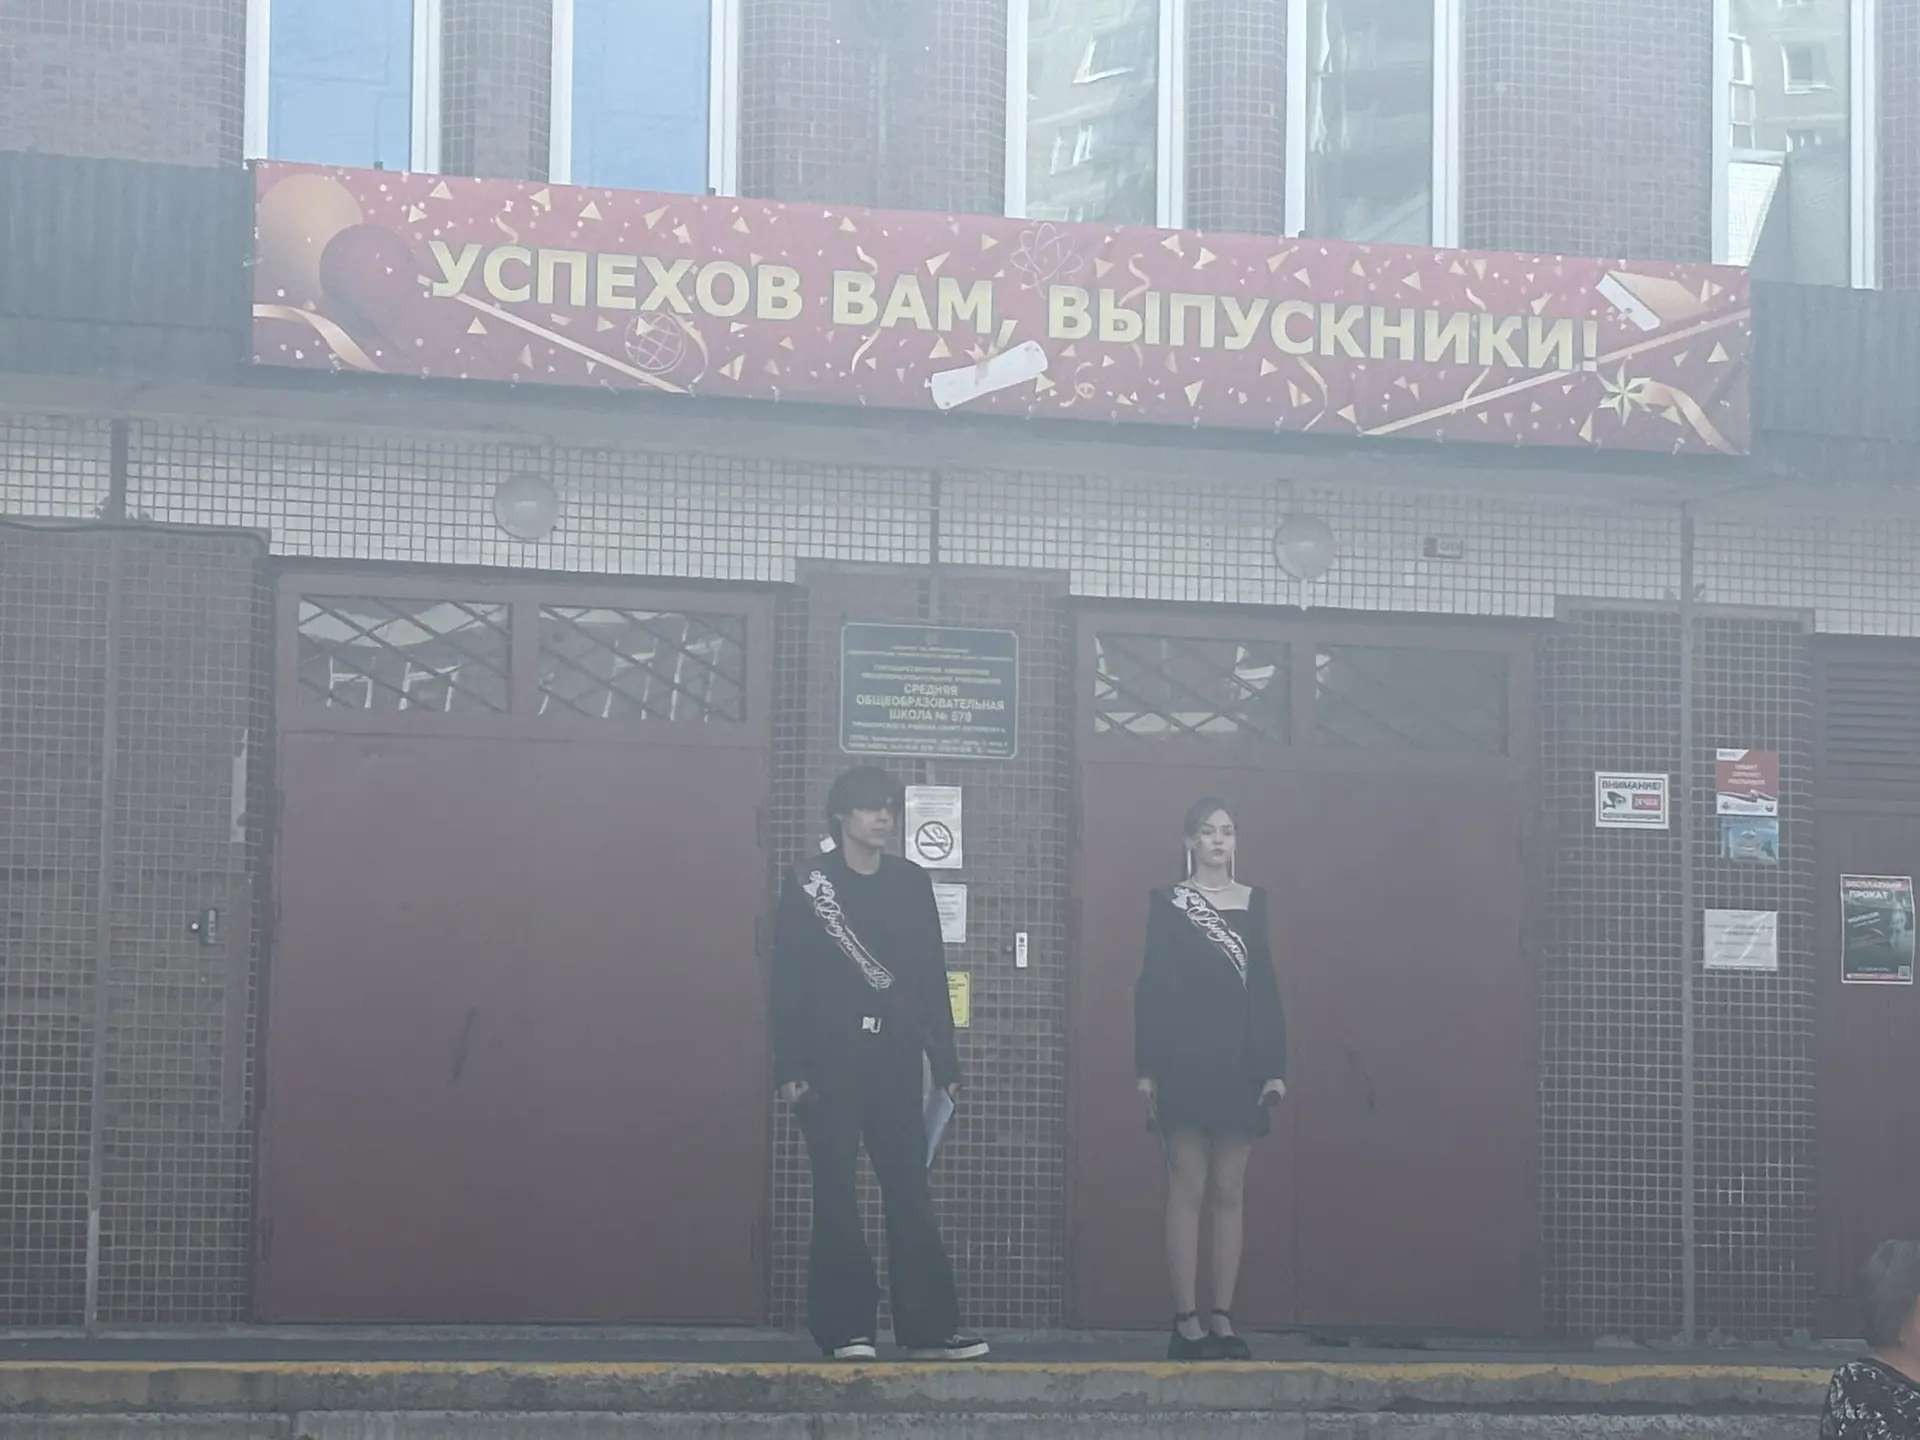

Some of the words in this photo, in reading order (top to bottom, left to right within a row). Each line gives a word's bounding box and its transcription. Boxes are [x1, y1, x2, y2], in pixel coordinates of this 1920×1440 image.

[428, 240, 804, 322] УСПЕХОВ
[831, 269, 1018, 348] ВАМ,
[1048, 285, 1598, 372] ВЫПУСКНИКИ!
[904, 683, 958, 696] СРЕДНЯЯ
[856, 694, 1005, 711] ОБЩЕОБРАЗОВАТЕЛЬНАЯ
[889, 708, 932, 721] ШКОЛА
[1602, 780, 1661, 791] ВНИМАНИЕ!
